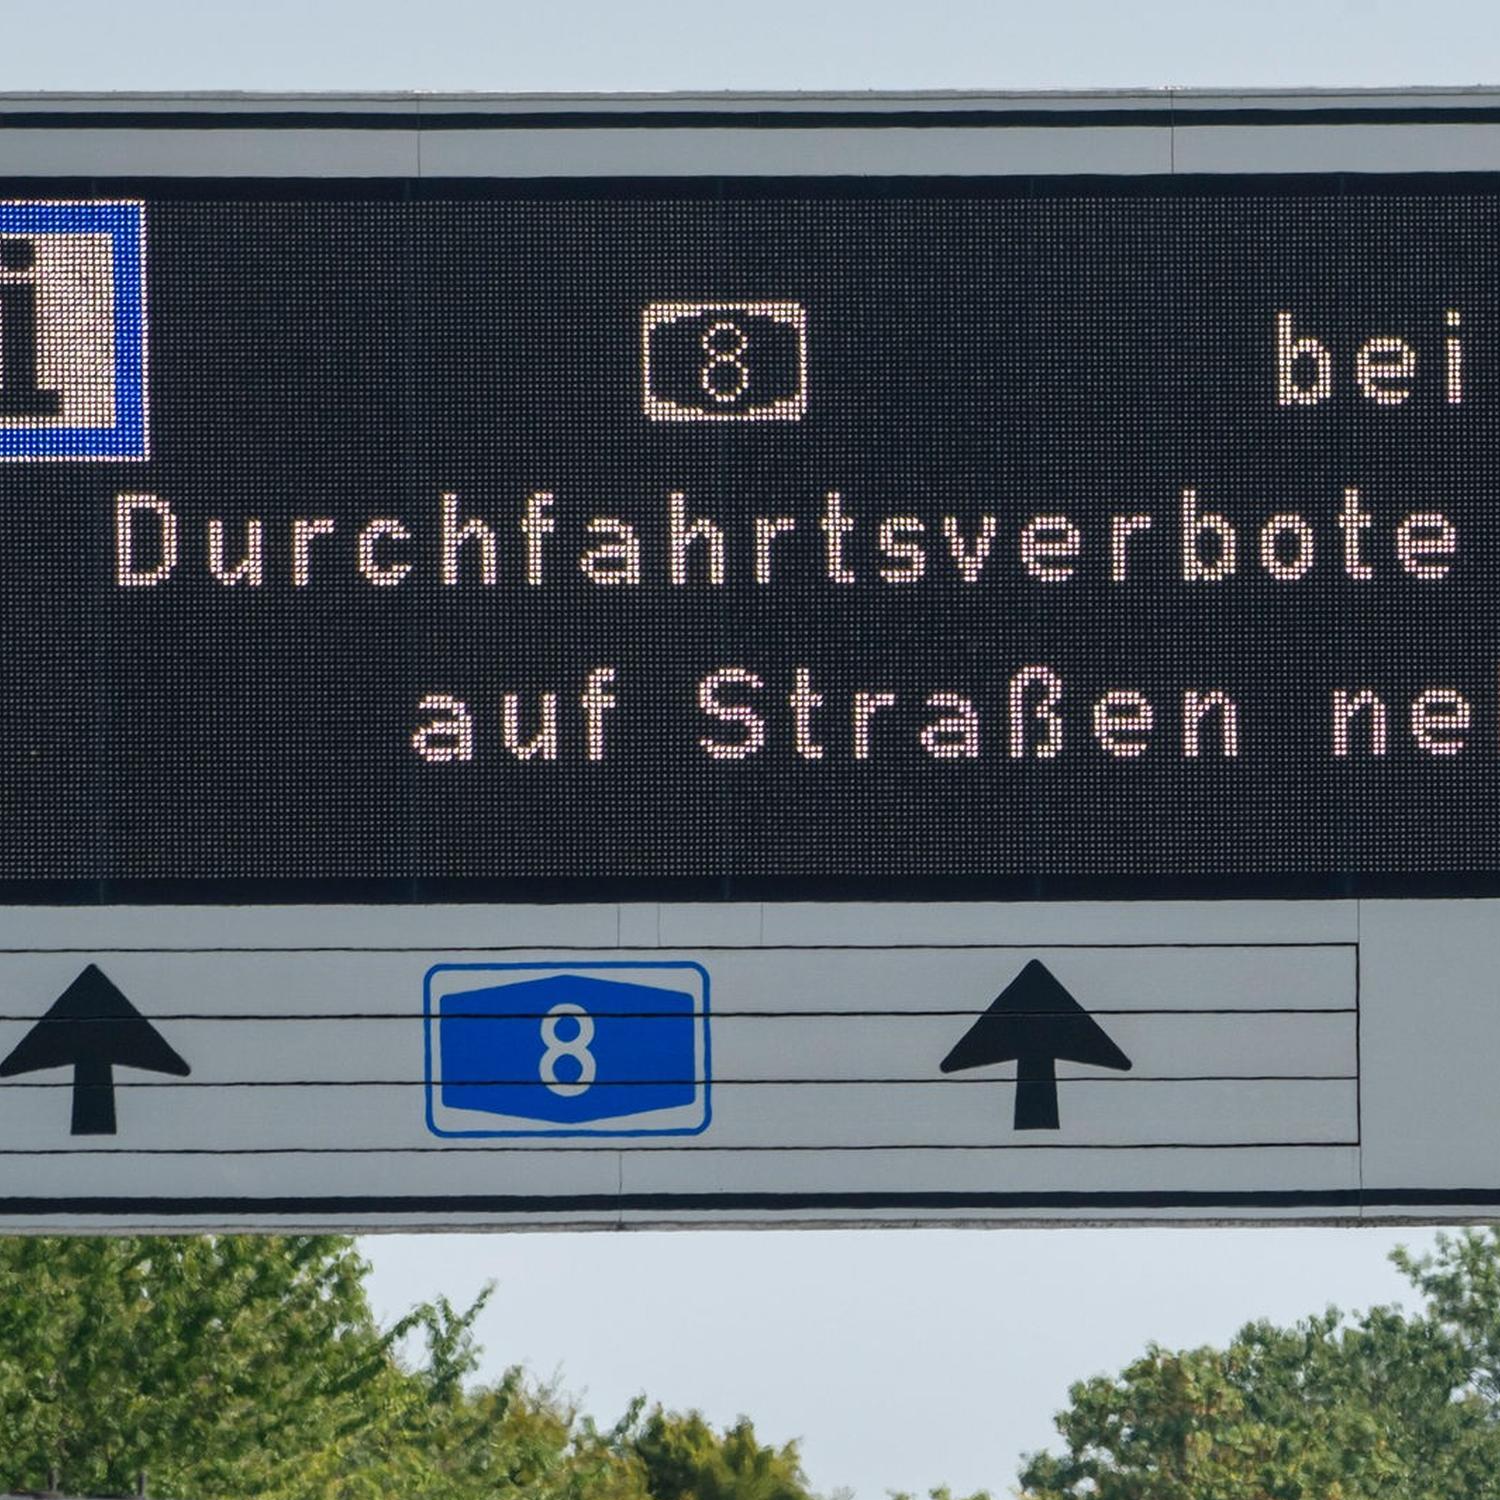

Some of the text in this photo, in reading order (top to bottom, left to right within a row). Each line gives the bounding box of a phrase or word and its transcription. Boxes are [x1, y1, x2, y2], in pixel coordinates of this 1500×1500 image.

[702, 321, 748, 402] 8
[1277, 311, 1462, 405] bei
[116, 488, 1457, 586] Durchfahrtsverbote
[412, 668, 616, 762] auf
[699, 665, 1239, 760] Straßen
[539, 1003, 596, 1096] 8
